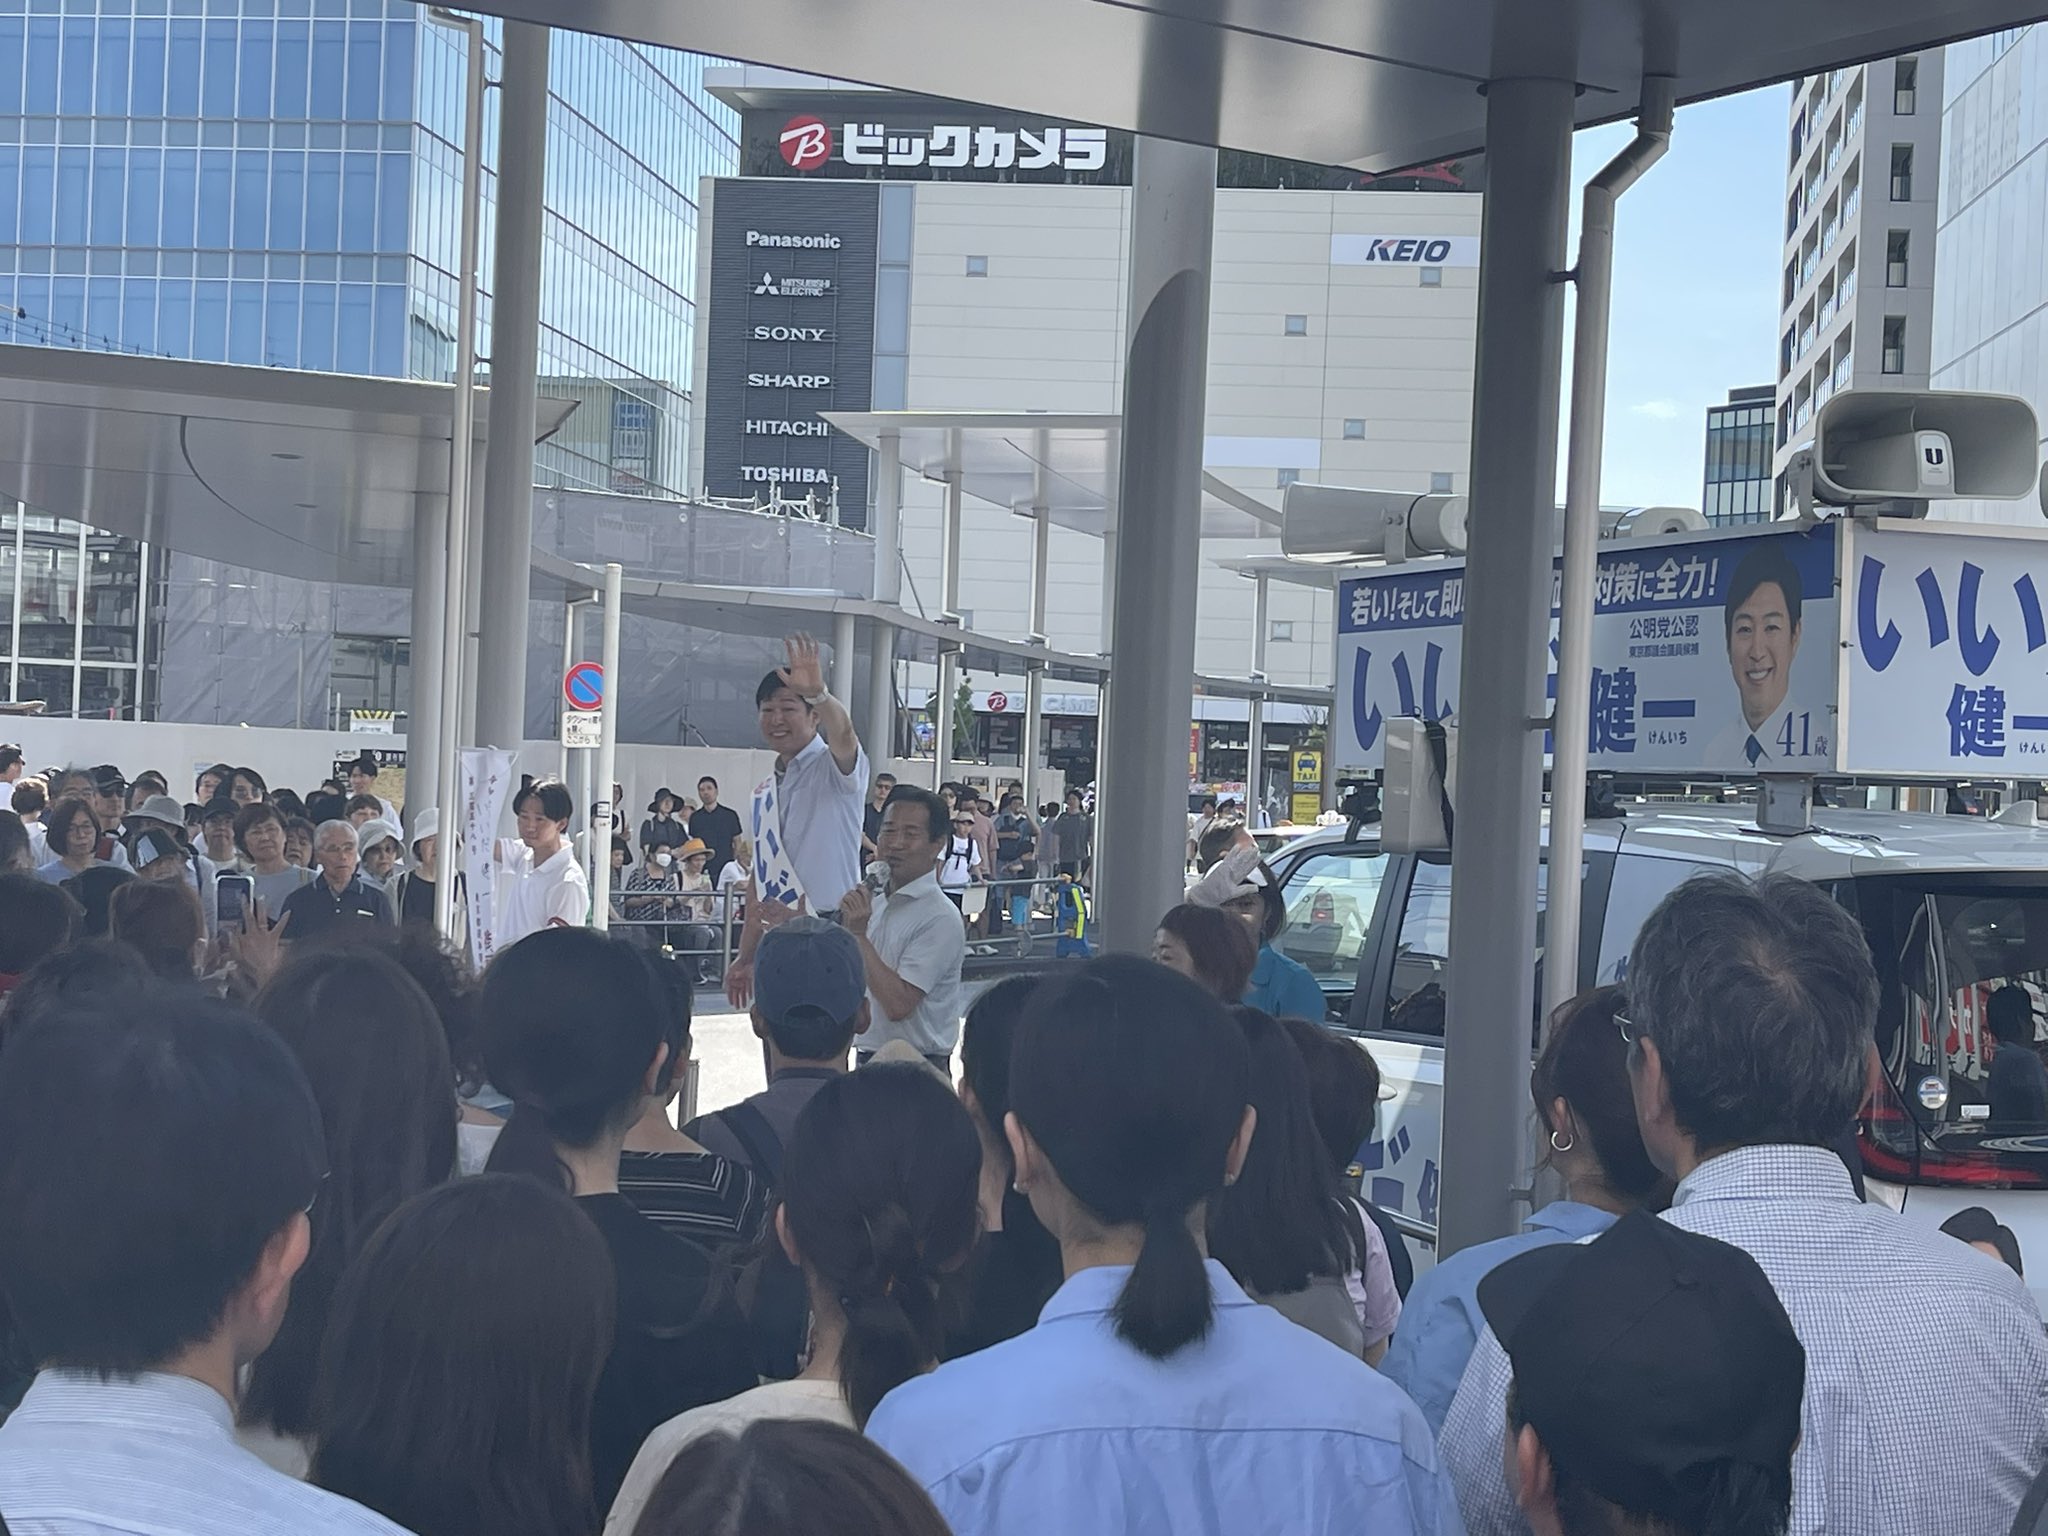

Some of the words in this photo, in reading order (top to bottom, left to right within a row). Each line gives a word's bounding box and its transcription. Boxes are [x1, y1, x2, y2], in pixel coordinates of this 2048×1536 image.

[843, 123, 1107, 170] ビックカメラ
[746, 230, 841, 249] Panasonic
[1366, 239, 1451, 262] KEIO
[780, 278, 831, 289] MITSUBISHI
[780, 287, 824, 297] ELECTRIC
[754, 326, 827, 342] SONY
[748, 373, 831, 389] SHARP
[745, 419, 828, 437] HITACHI
[741, 465, 830, 484] TOSHIBA
[1628, 614, 1700, 640] 公明党公認
[1647, 730, 1688, 745] けんいち
[1297, 772, 1317, 781] TAXI
